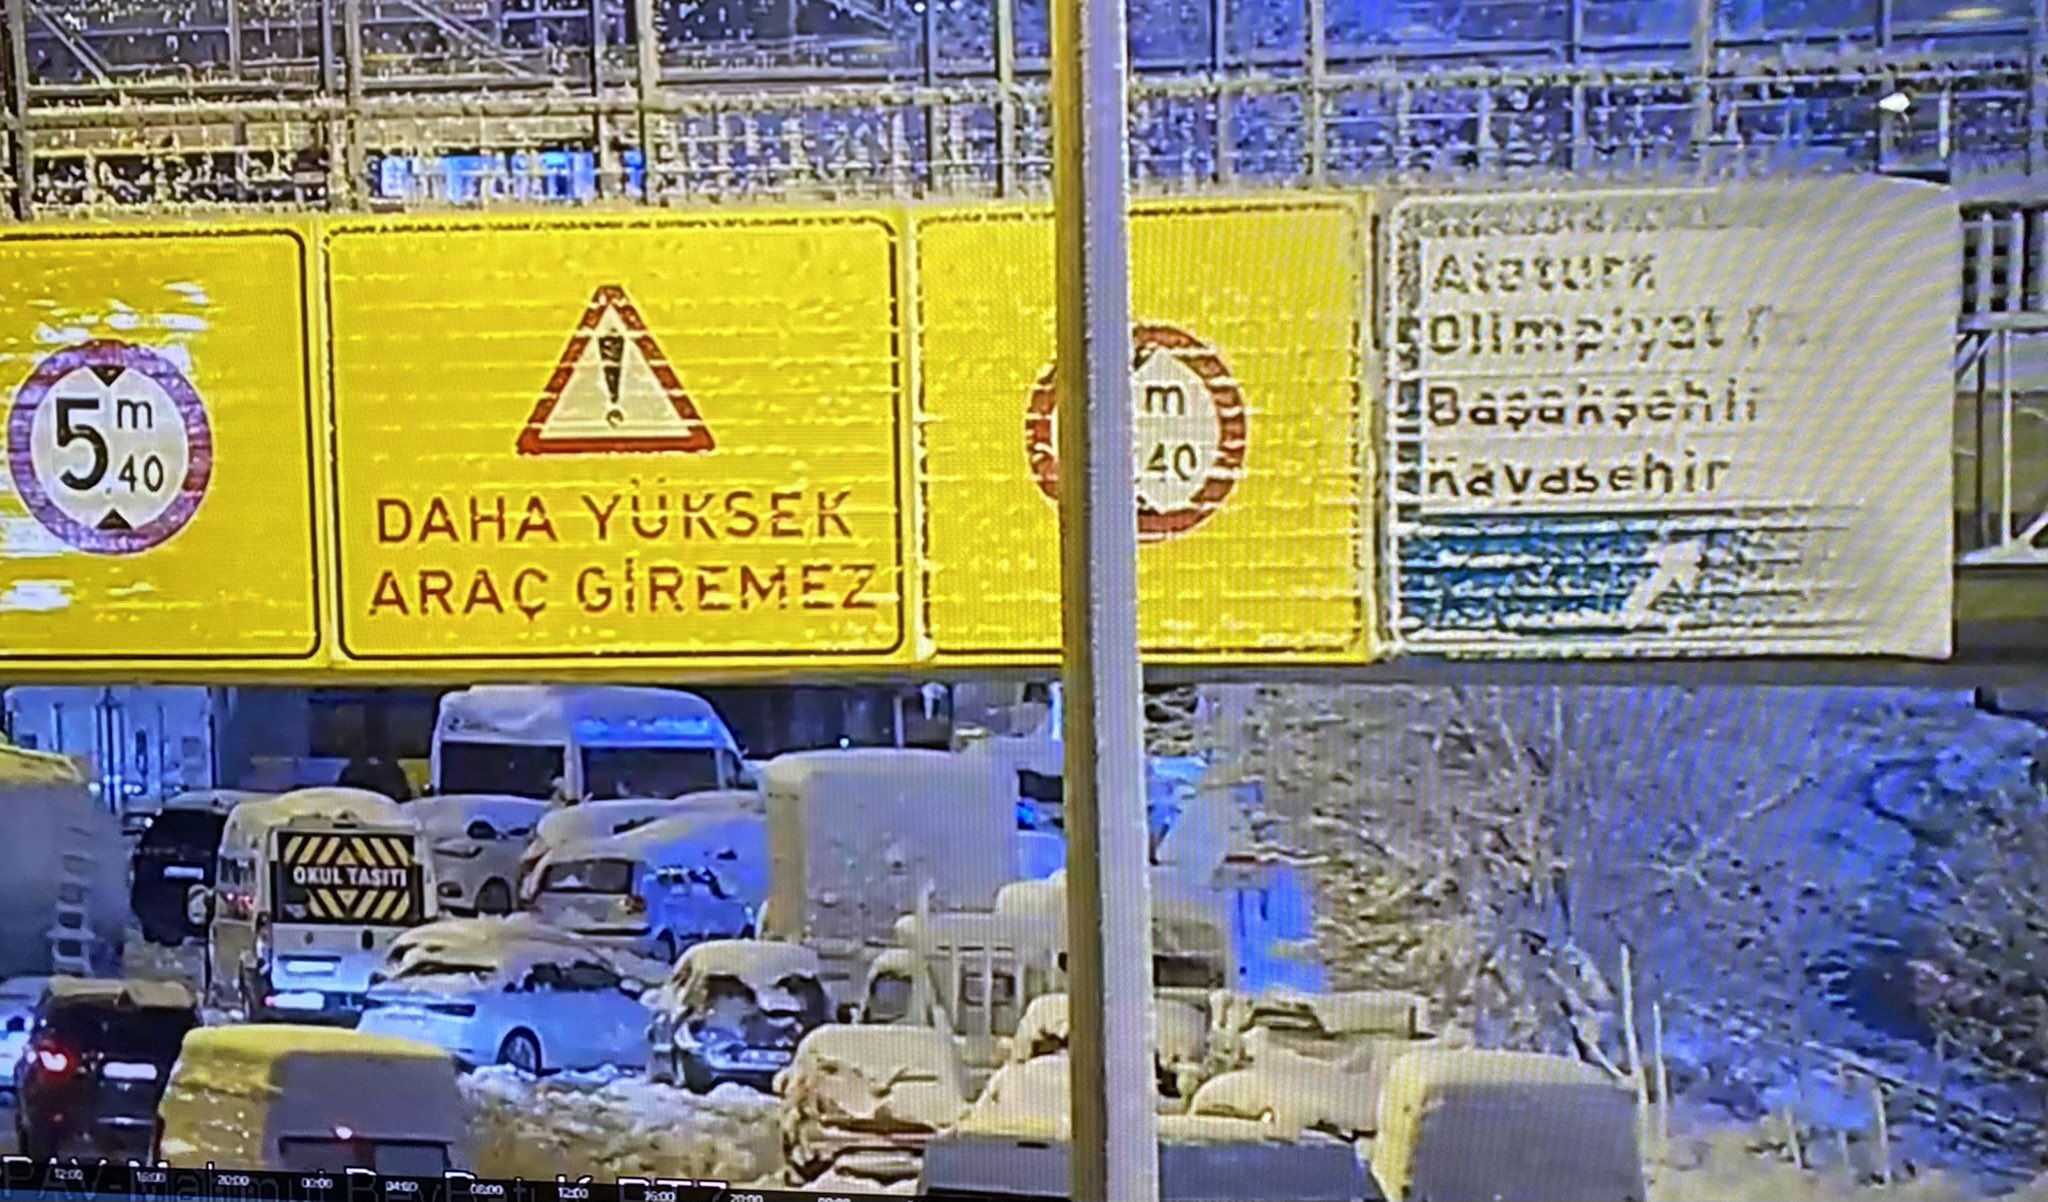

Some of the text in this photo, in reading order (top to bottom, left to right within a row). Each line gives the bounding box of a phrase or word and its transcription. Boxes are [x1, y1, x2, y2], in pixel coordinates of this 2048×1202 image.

[1147, 386, 1185, 415] m
[56, 397, 153, 491] 5 m
[377, 478, 853, 543] DAHA YÜKSEK
[368, 557, 878, 622] ARAÇ GİREMEZ
[293, 866, 343, 885] OKUL
[217, 1174, 250, 1186] 20:00
